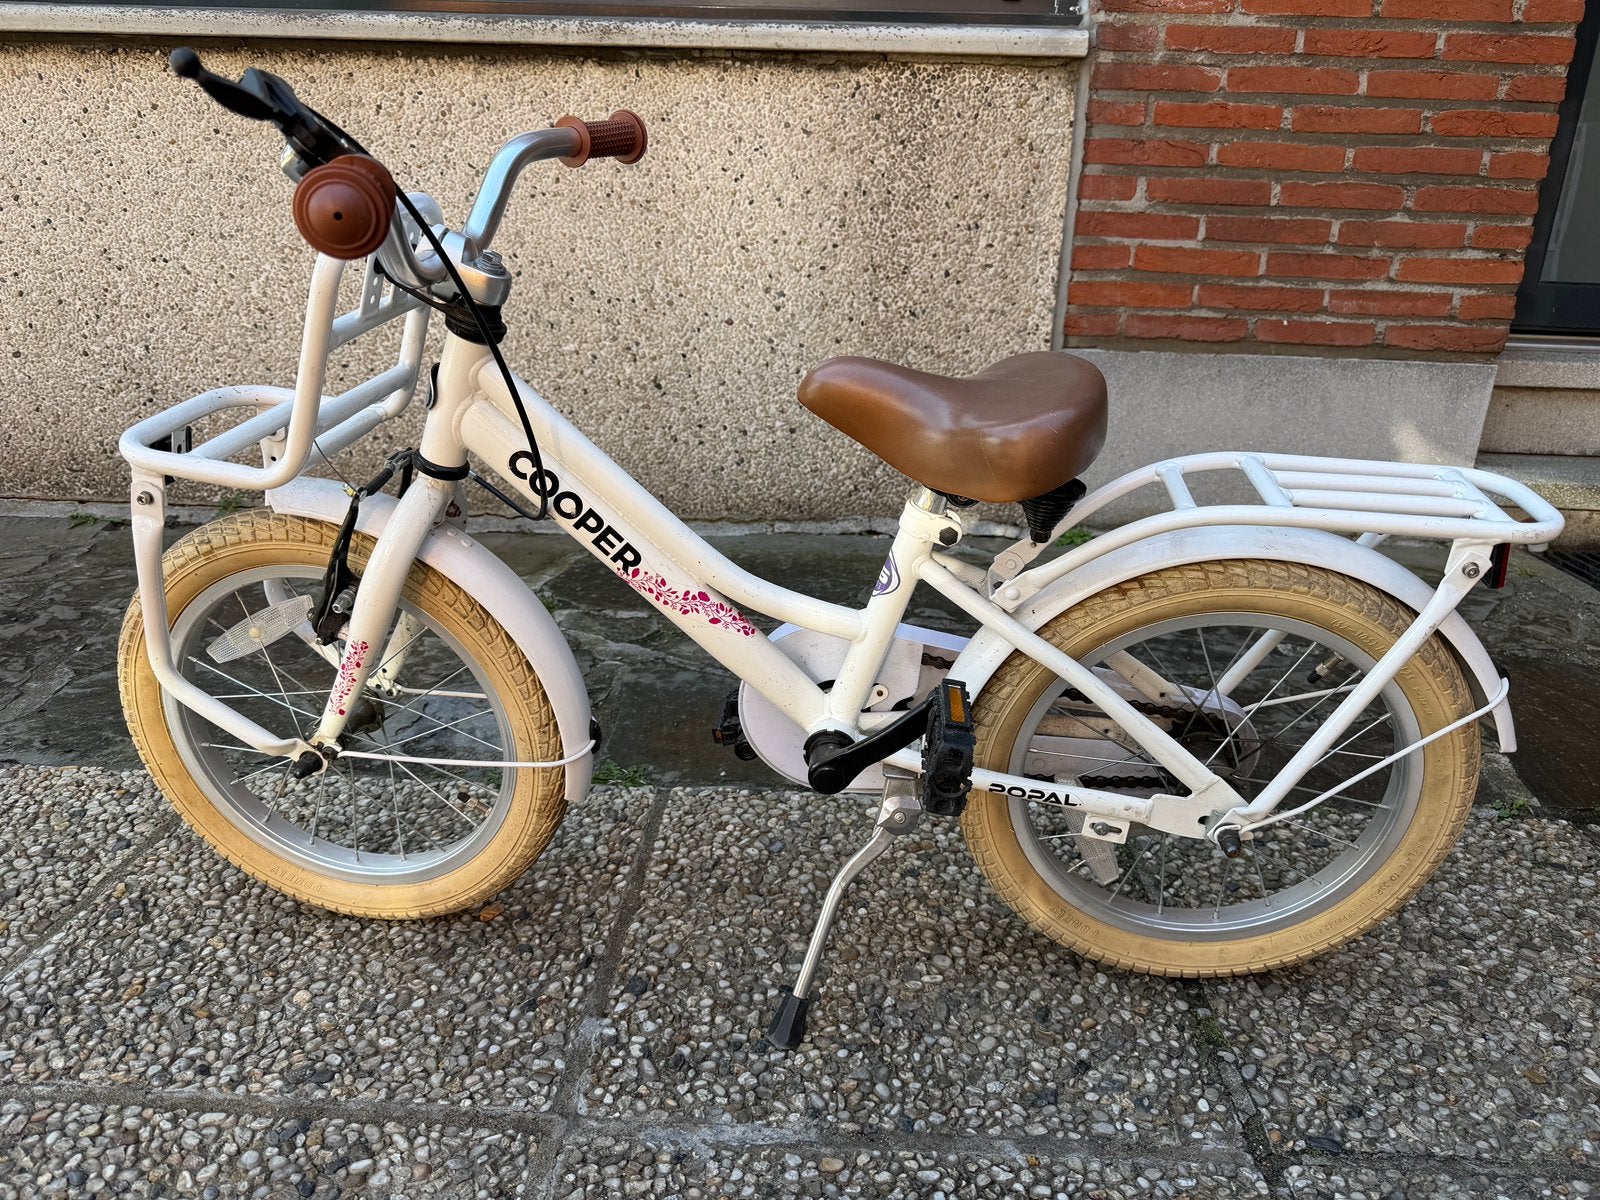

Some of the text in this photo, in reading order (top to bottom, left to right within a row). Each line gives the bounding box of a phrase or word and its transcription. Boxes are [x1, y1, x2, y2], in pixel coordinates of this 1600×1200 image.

[508, 450, 642, 576] COOPER
[1401, 841, 1423, 871] INFLATE
[1389, 872, 1401, 882] TO
